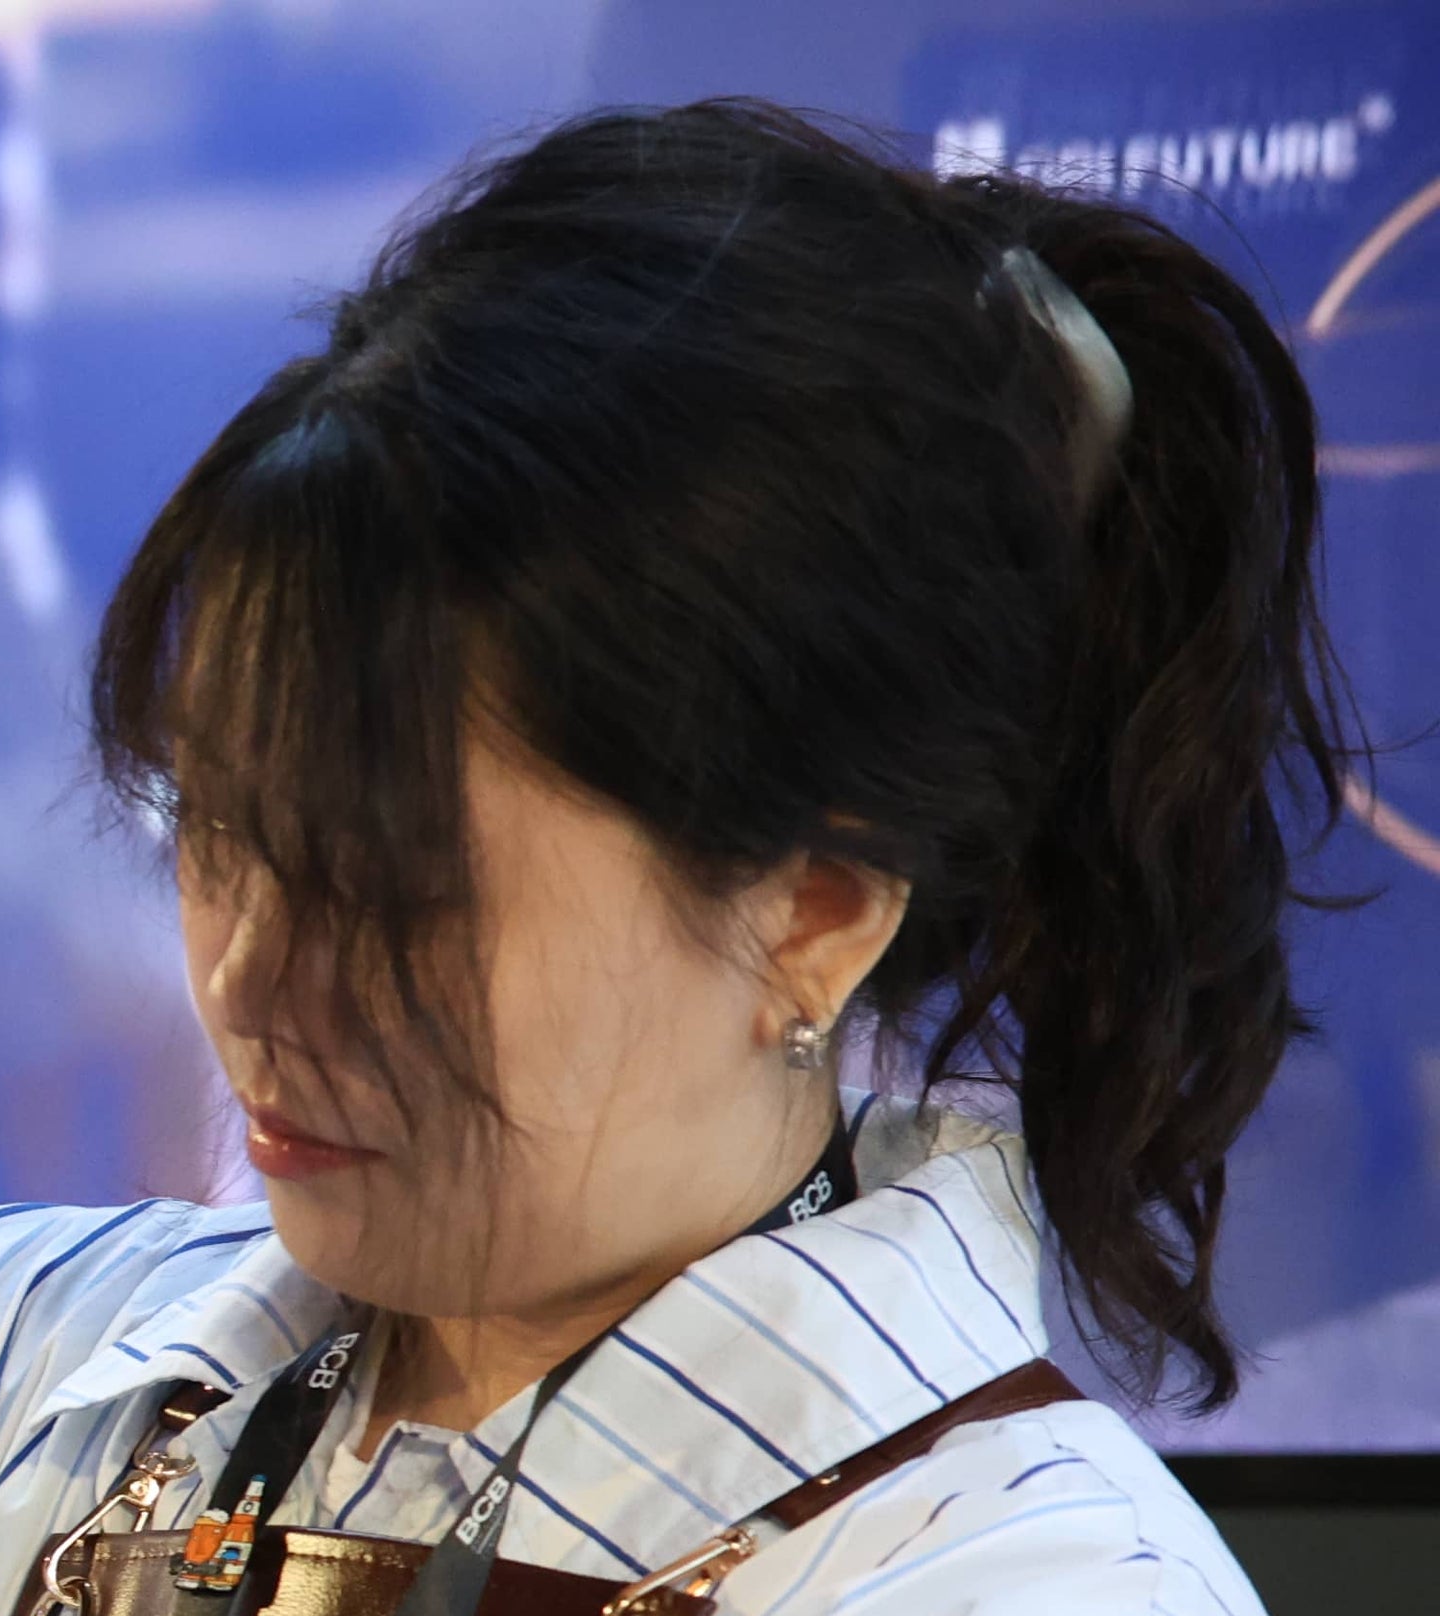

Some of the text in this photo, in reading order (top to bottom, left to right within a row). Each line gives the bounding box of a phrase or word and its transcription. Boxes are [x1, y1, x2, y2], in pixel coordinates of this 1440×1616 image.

[788, 1170, 833, 1224] BCB
[308, 1333, 360, 1388] BCB
[455, 1475, 509, 1545] BCB
